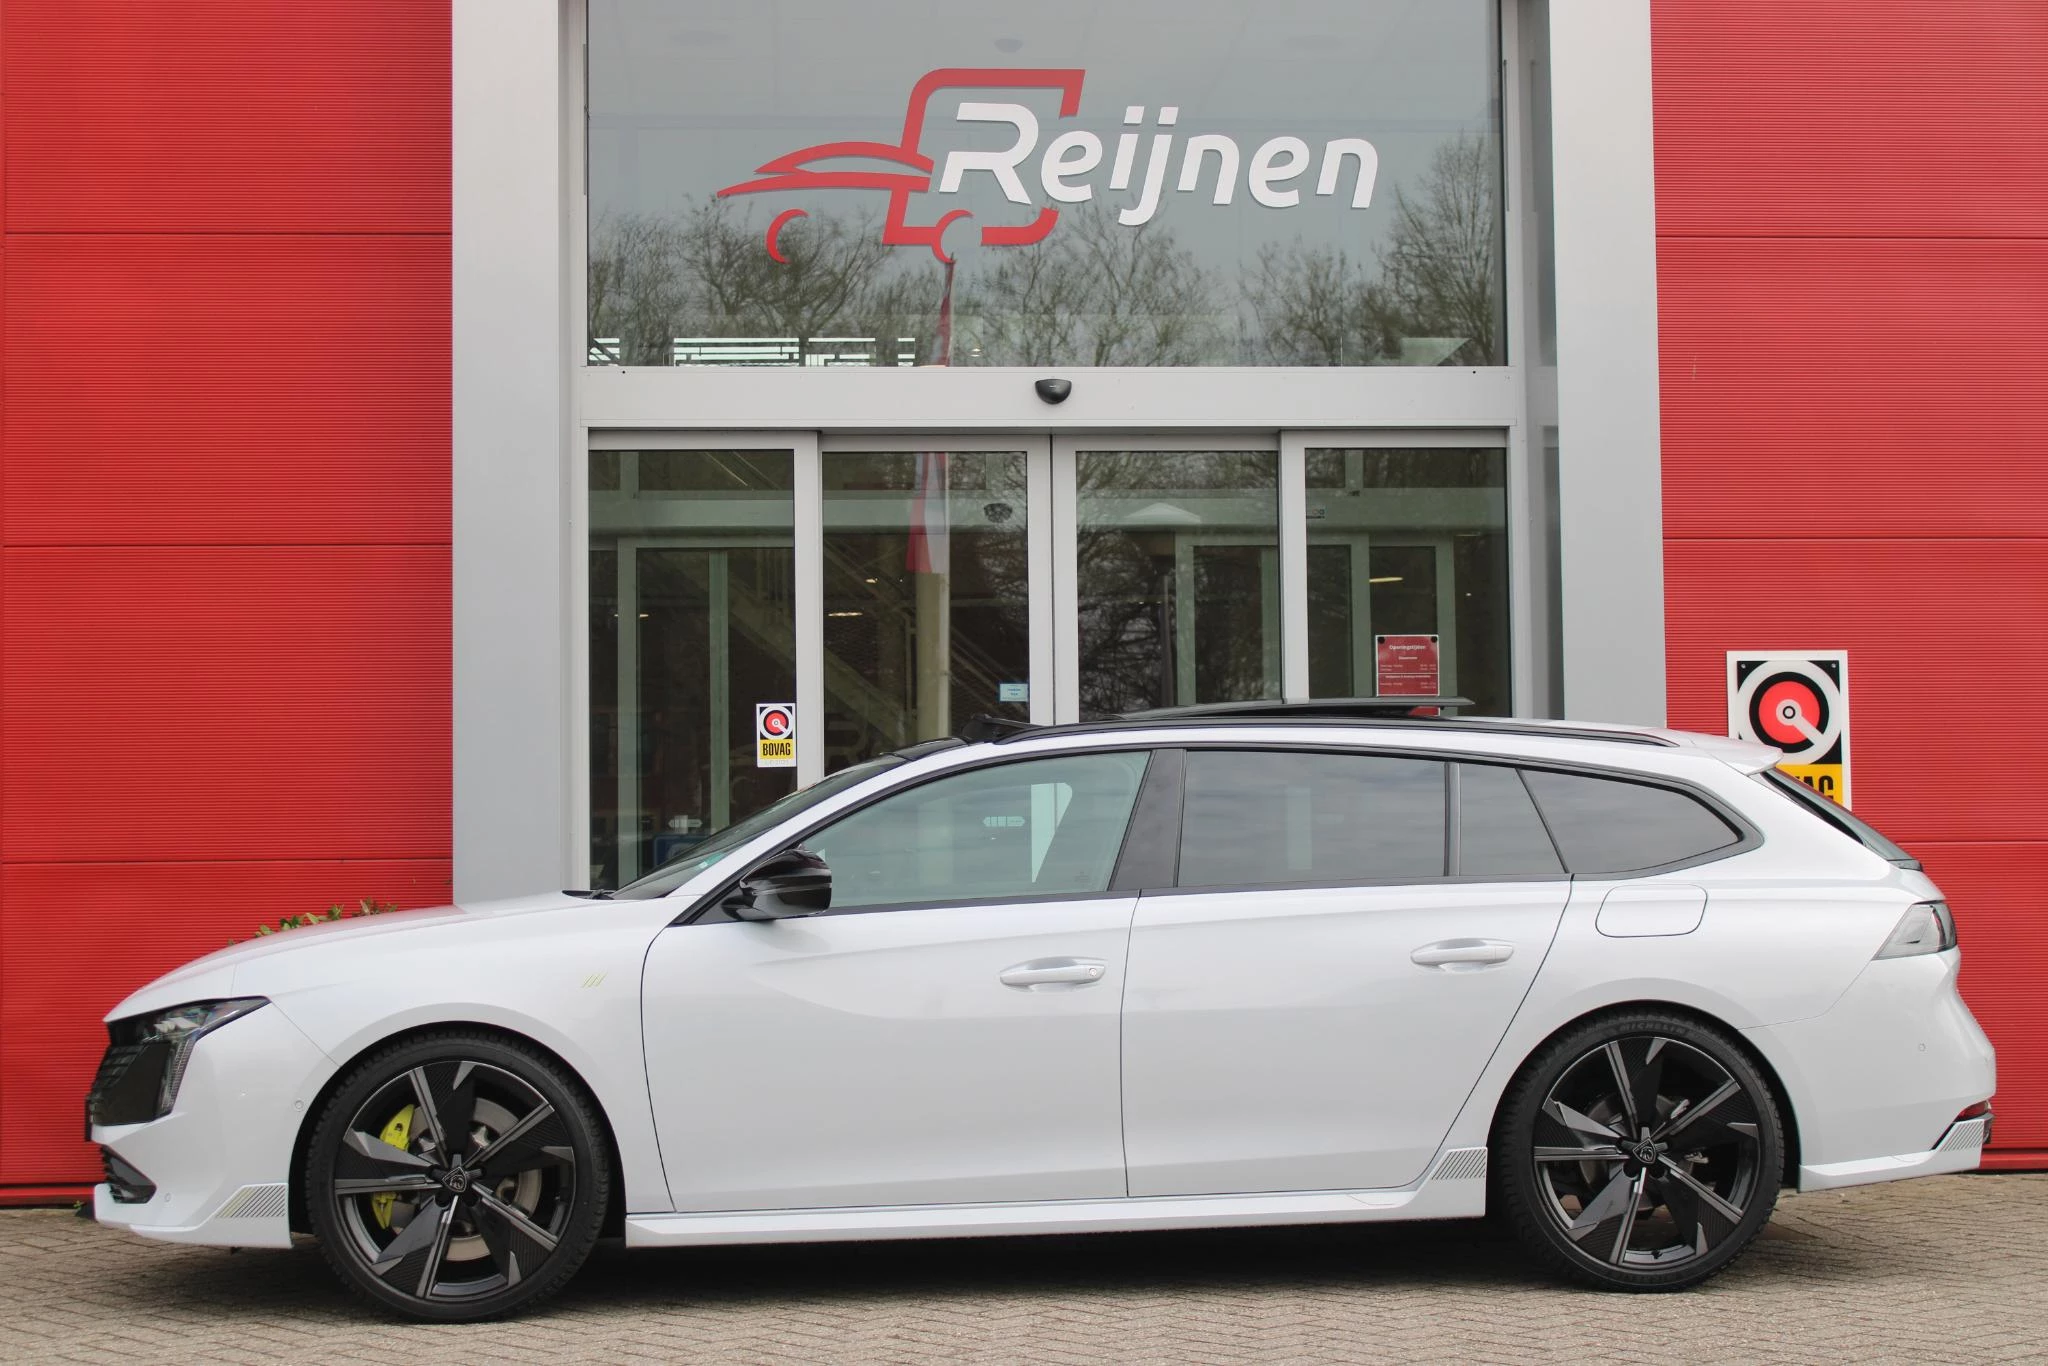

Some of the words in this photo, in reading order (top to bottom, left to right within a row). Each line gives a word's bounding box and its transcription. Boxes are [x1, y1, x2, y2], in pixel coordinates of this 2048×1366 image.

[939, 102, 1379, 227] Reijnen
[762, 743, 791, 756] BOVAG
[1619, 1022, 1686, 1034] MICHELIN
